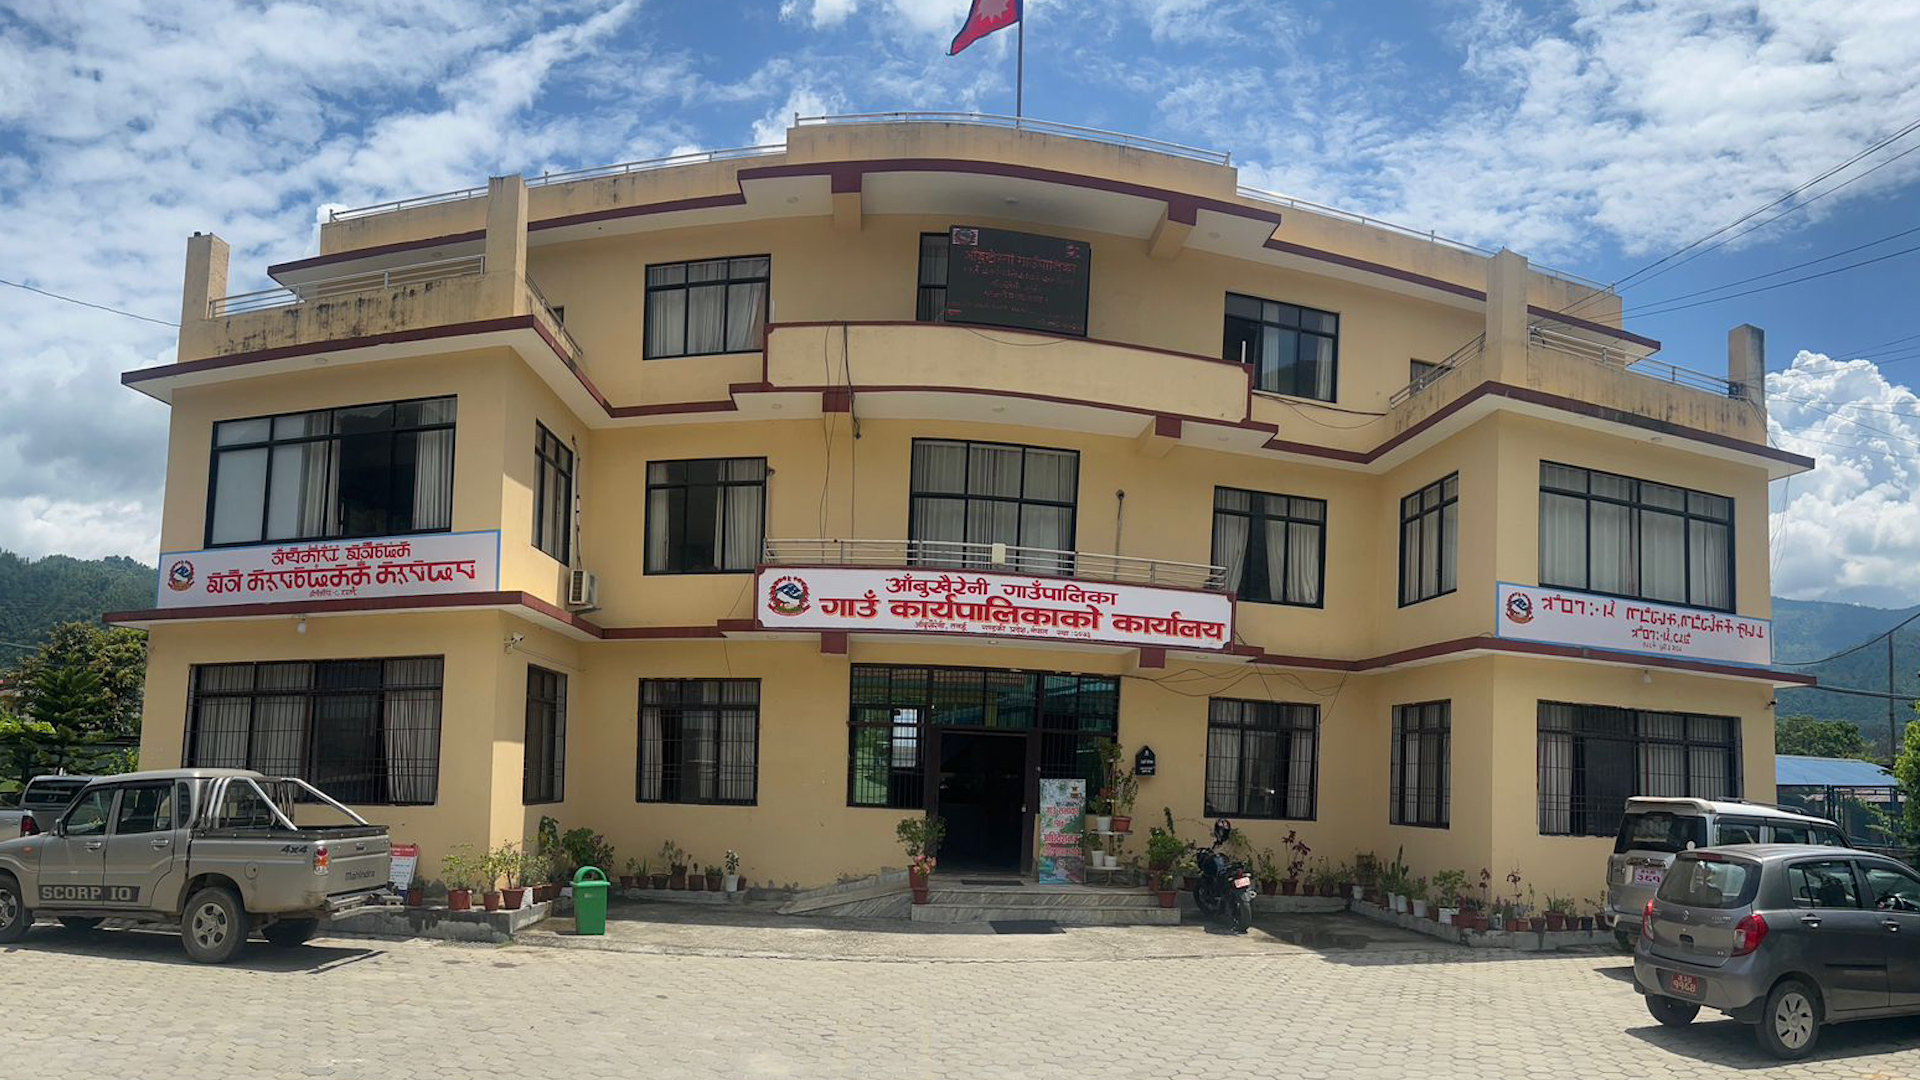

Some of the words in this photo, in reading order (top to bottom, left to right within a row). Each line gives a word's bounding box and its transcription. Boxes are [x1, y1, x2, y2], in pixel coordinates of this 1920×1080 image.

[1001, 580, 1119, 606] गाउँपालिका
[818, 589, 880, 619] गाउँ
[887, 593, 1103, 630] कार्यपालिकाको
[1111, 611, 1226, 642] कार्यालय
